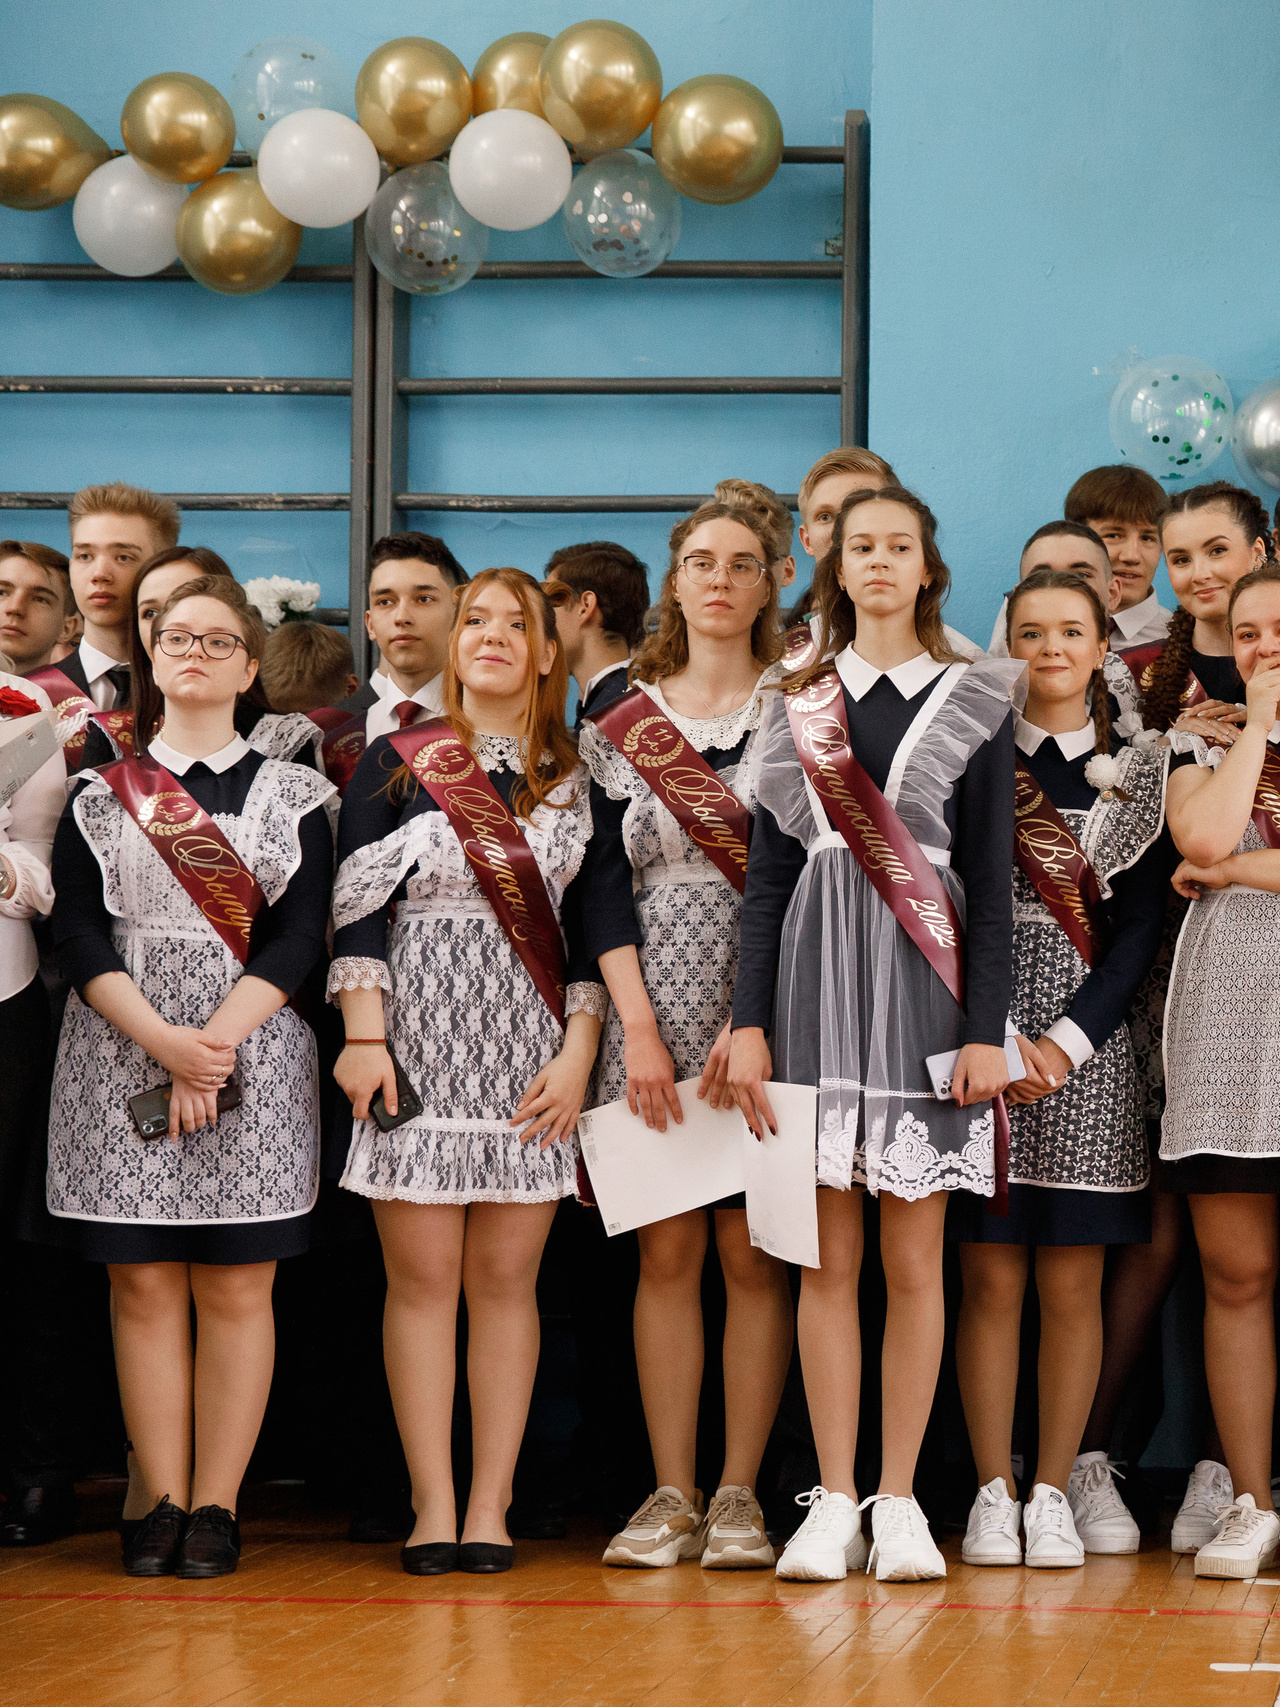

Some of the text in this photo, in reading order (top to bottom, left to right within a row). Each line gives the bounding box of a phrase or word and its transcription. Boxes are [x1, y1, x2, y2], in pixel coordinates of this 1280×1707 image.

[819, 676, 833, 689] 11
[654, 728, 674, 742] 11
[446, 749, 465, 763] 11
[1015, 782, 1034, 796] 11
[801, 715, 915, 885] Выпускница
[172, 802, 192, 814] 11
